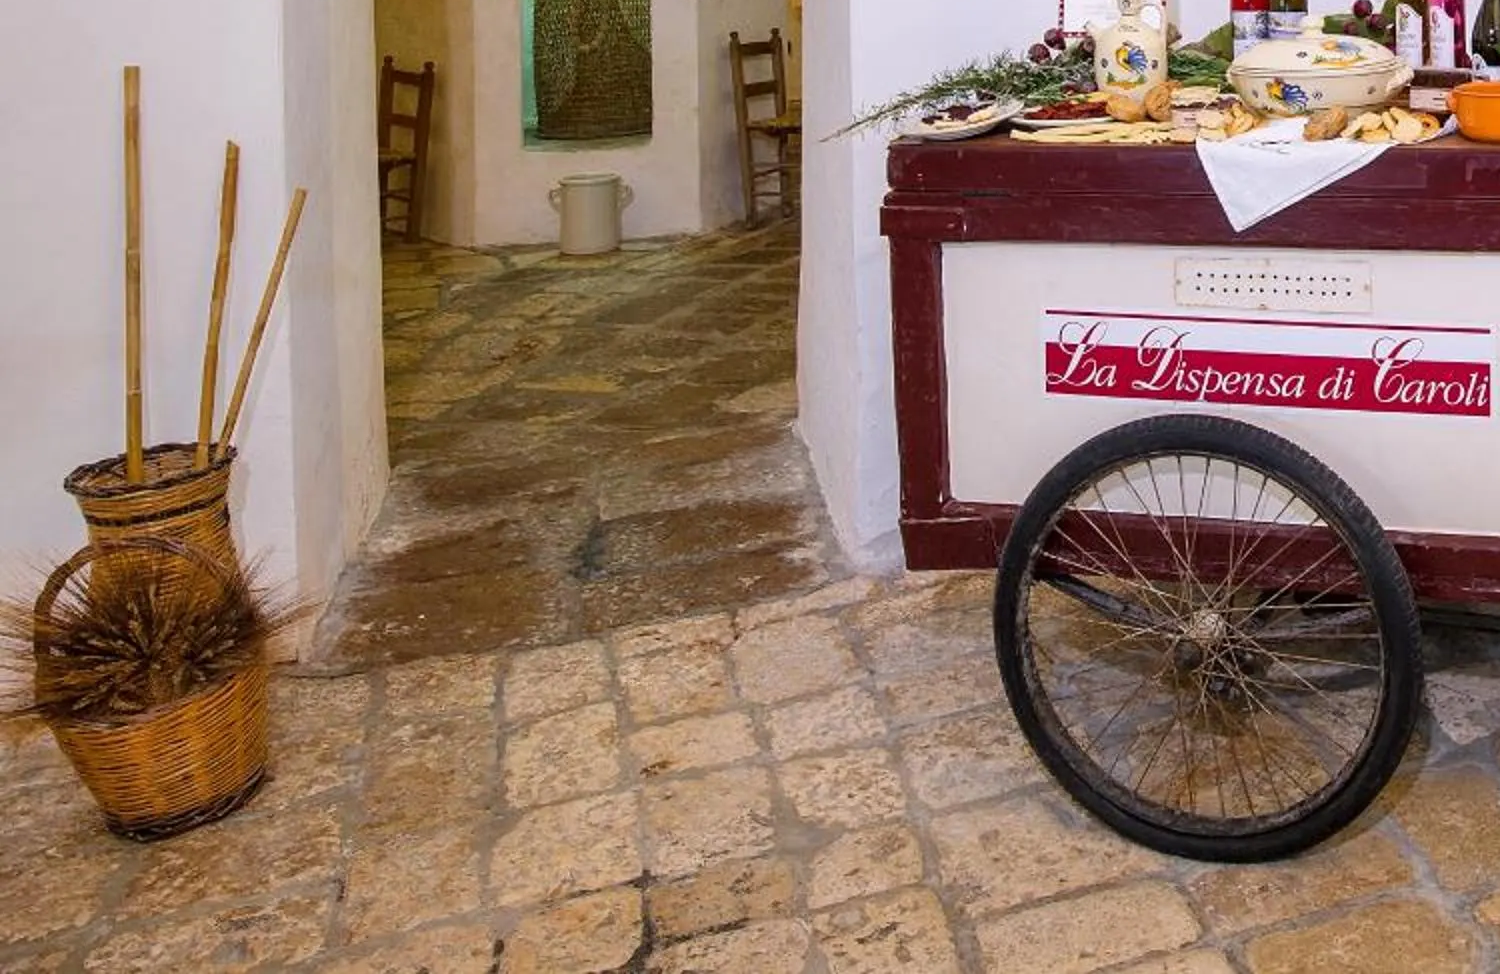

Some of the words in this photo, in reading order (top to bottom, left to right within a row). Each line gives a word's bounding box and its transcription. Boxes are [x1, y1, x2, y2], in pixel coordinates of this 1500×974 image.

[1047, 321, 1117, 386] La
[1131, 325, 1306, 401] Dispensa
[1317, 367, 1355, 401] di
[1371, 336, 1490, 407] Caroli
